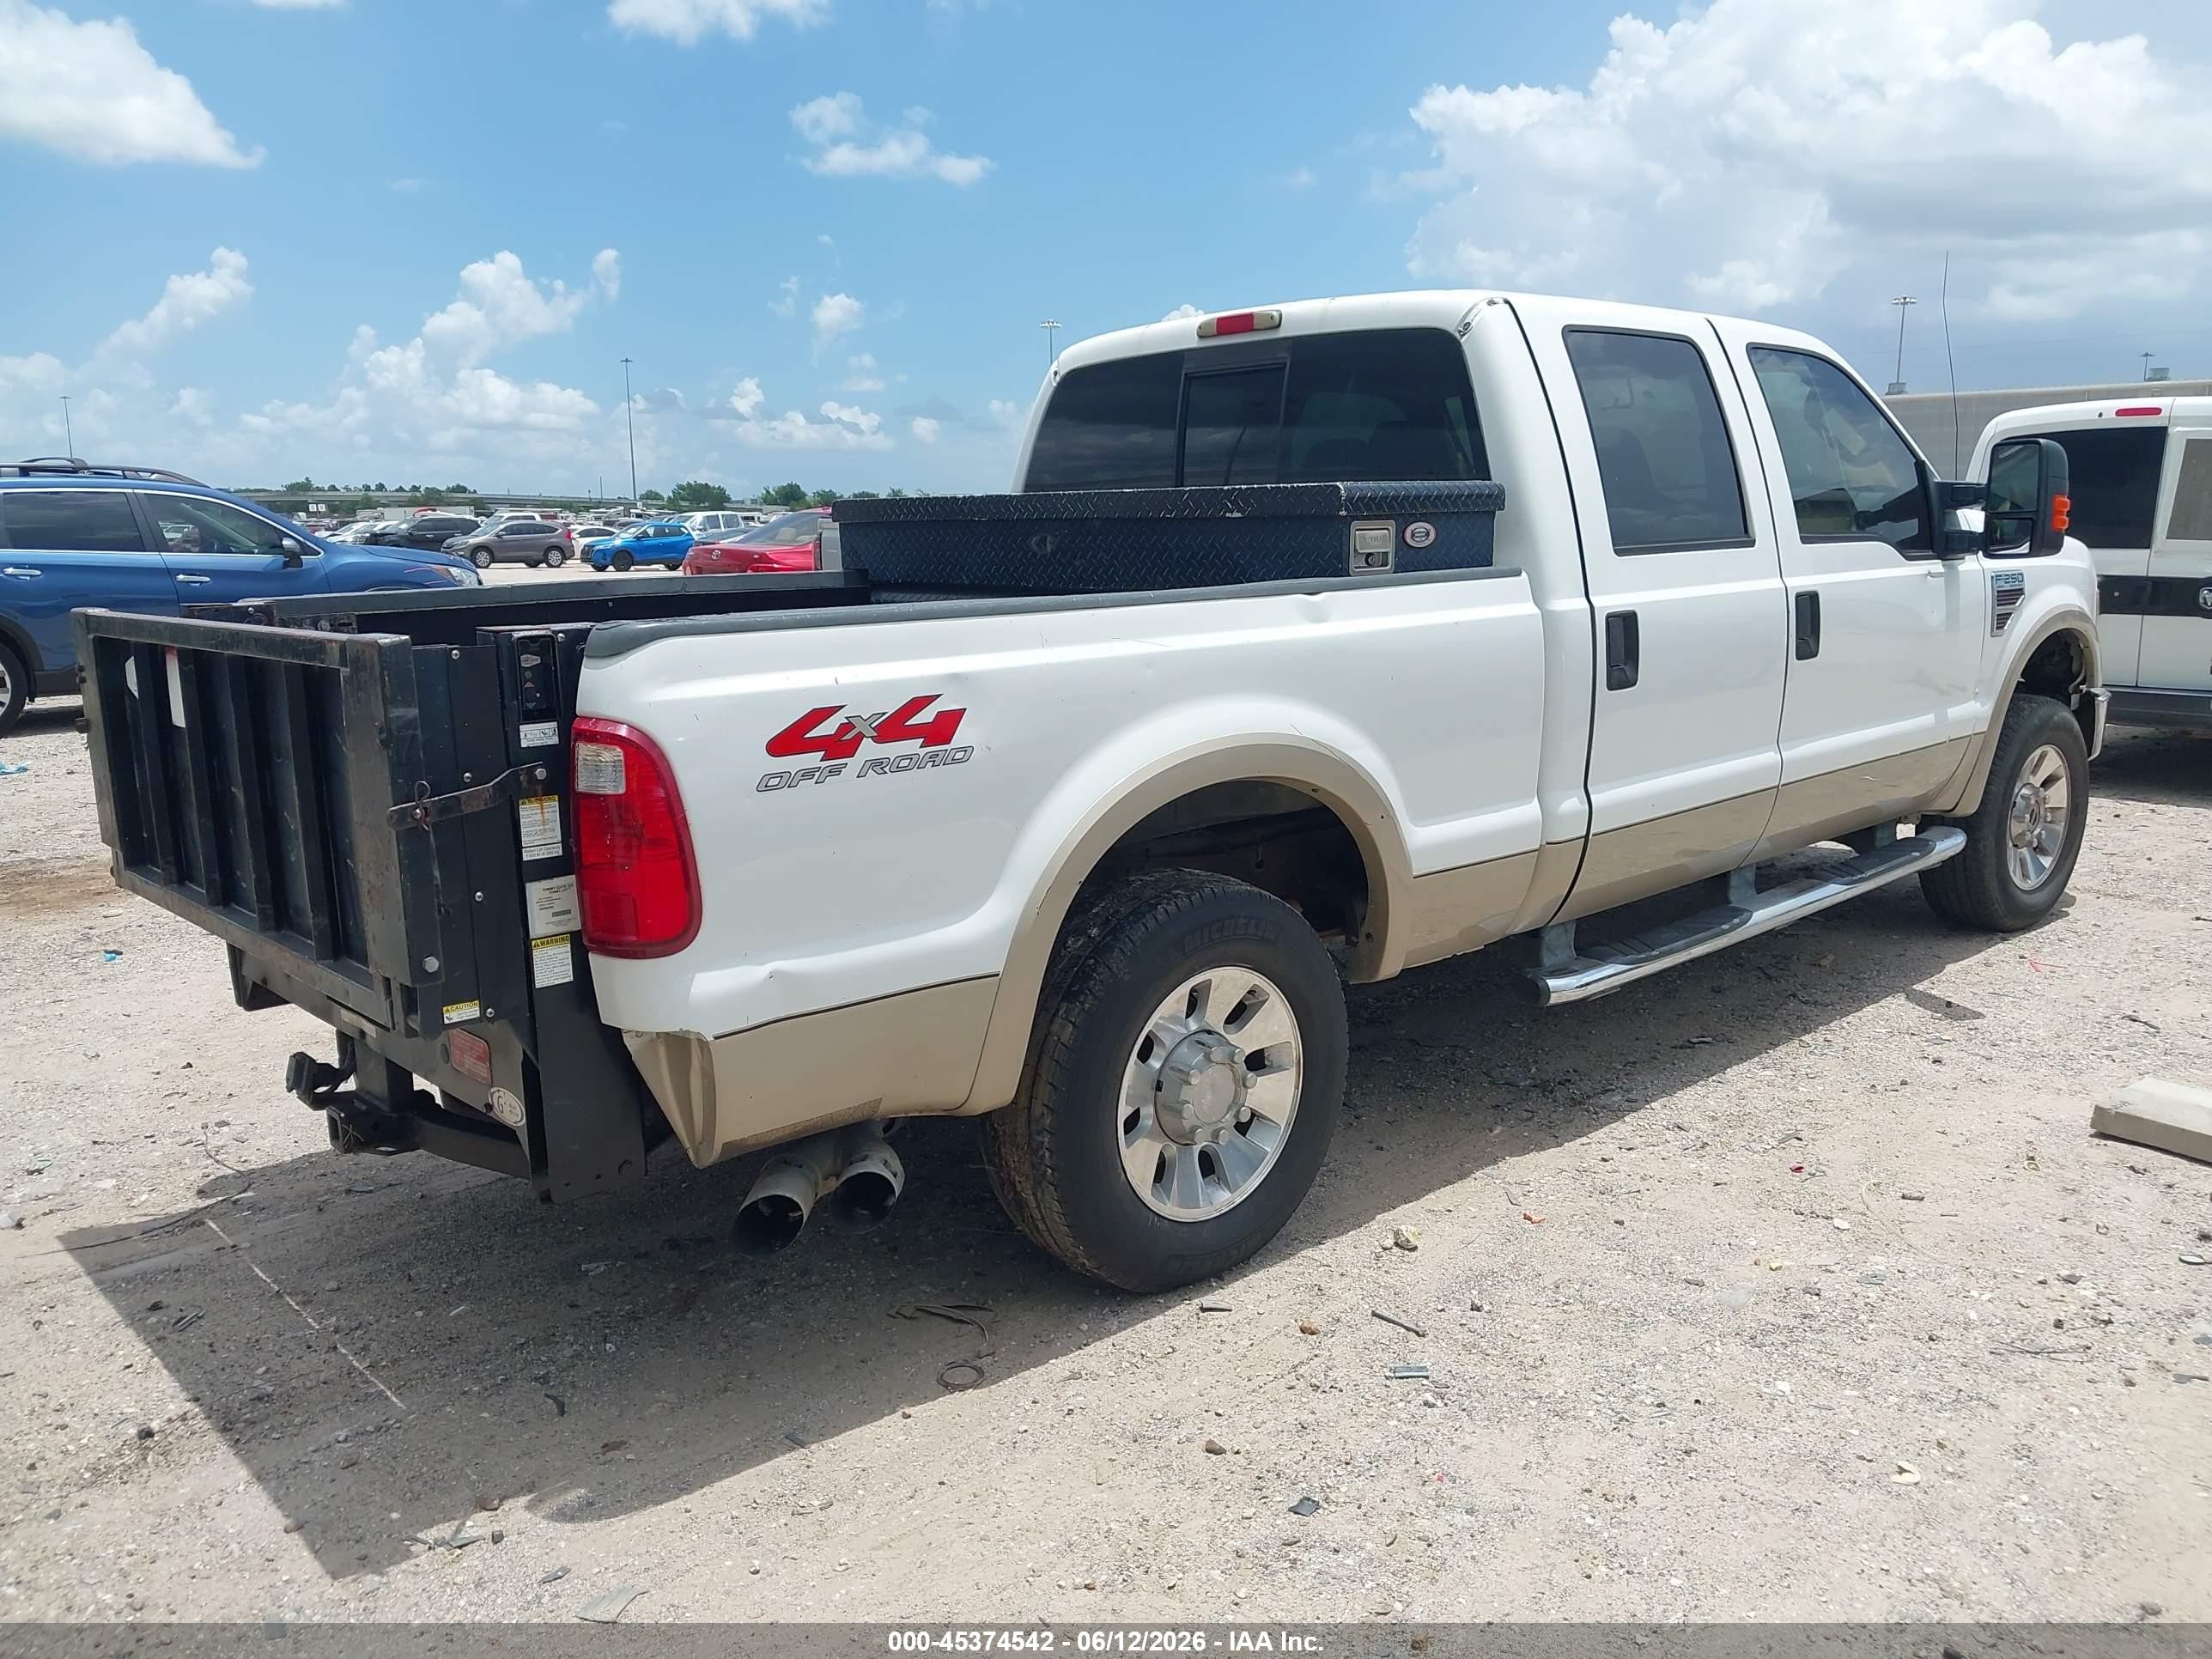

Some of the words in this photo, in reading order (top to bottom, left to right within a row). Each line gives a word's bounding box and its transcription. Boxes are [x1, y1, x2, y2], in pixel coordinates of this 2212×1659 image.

[1995, 573, 2024, 585] F-250
[756, 763, 848, 793] OFF
[856, 745, 975, 779] ROAD
[1182, 915, 1280, 954] MICHELIN
[539, 935, 569, 947] WARNING
[450, 1002, 479, 1012] CAUTION
